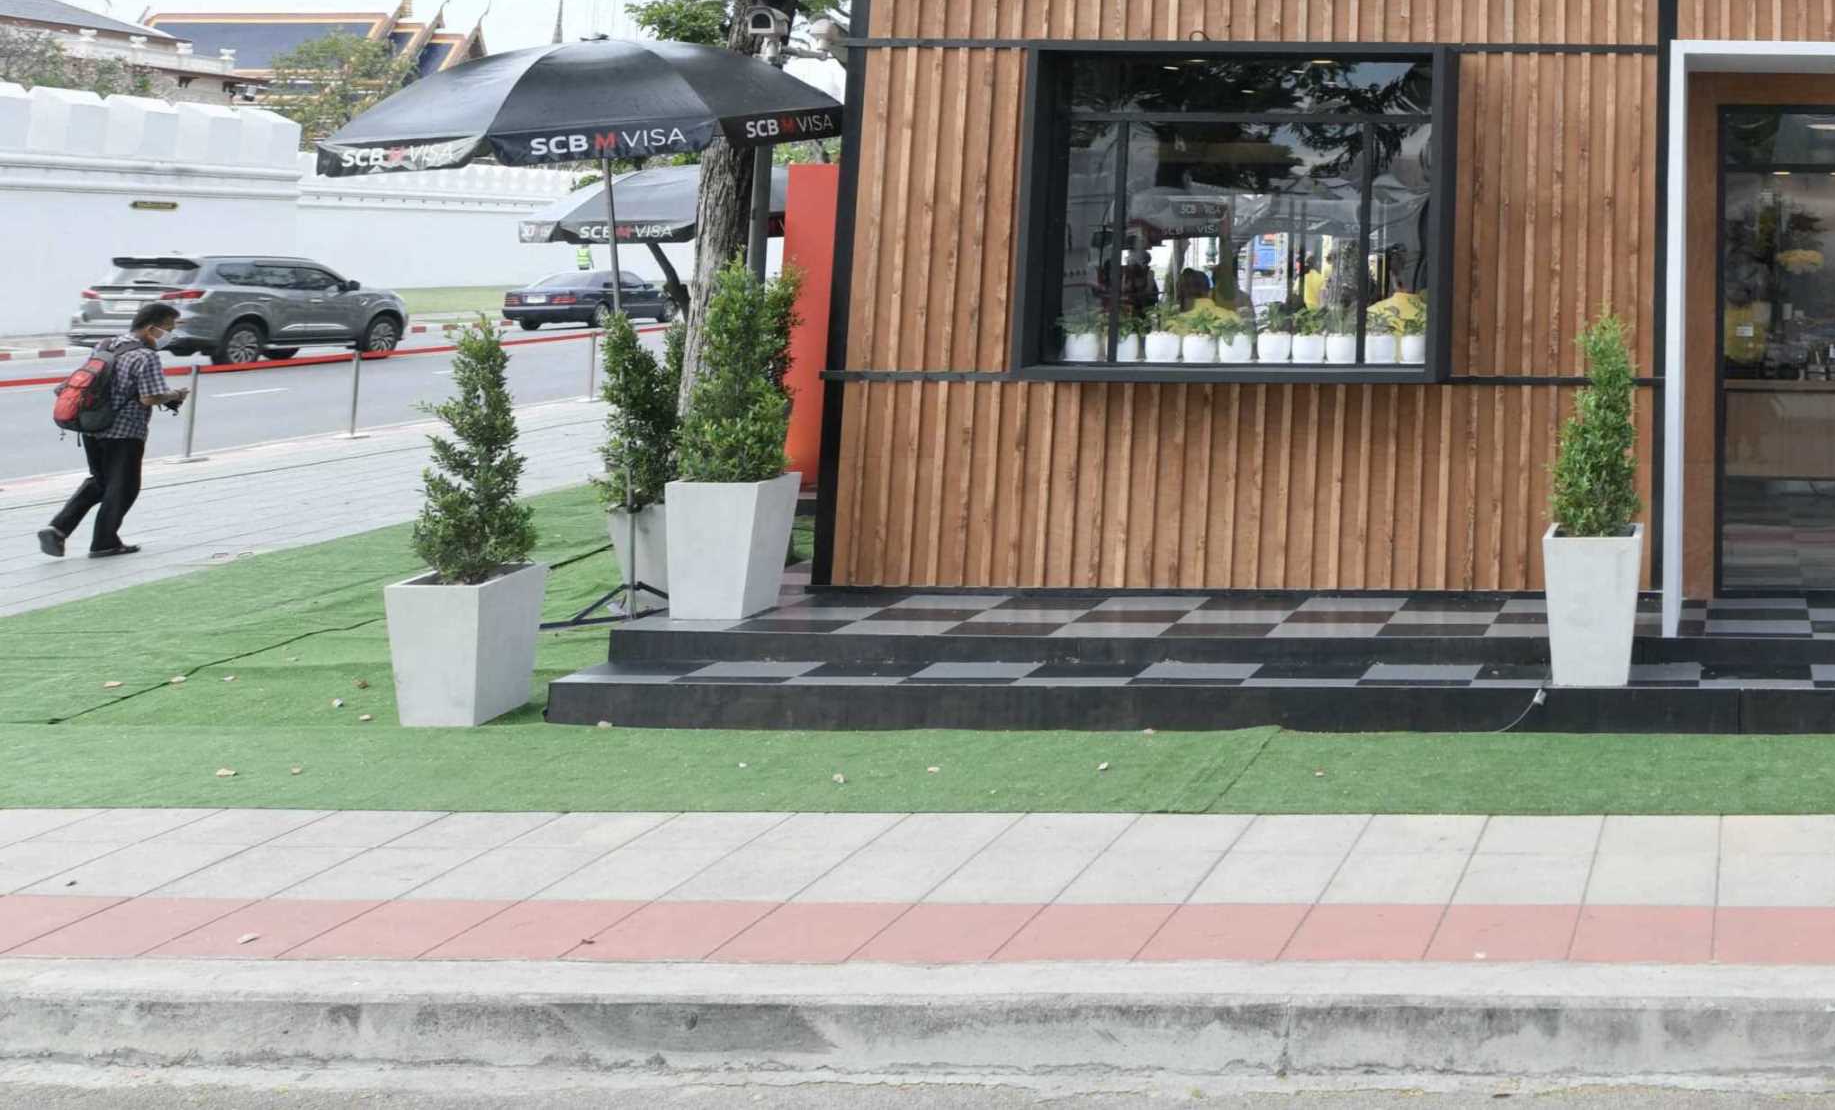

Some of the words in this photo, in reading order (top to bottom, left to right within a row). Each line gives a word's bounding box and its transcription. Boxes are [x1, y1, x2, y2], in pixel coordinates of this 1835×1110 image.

[746, 119, 780, 138] SCB
[796, 114, 834, 132] VISA
[530, 134, 588, 155] SCB
[594, 131, 618, 150] M
[622, 127, 687, 148] VISA
[341, 148, 384, 168] SCB
[634, 225, 673, 238] VISA
